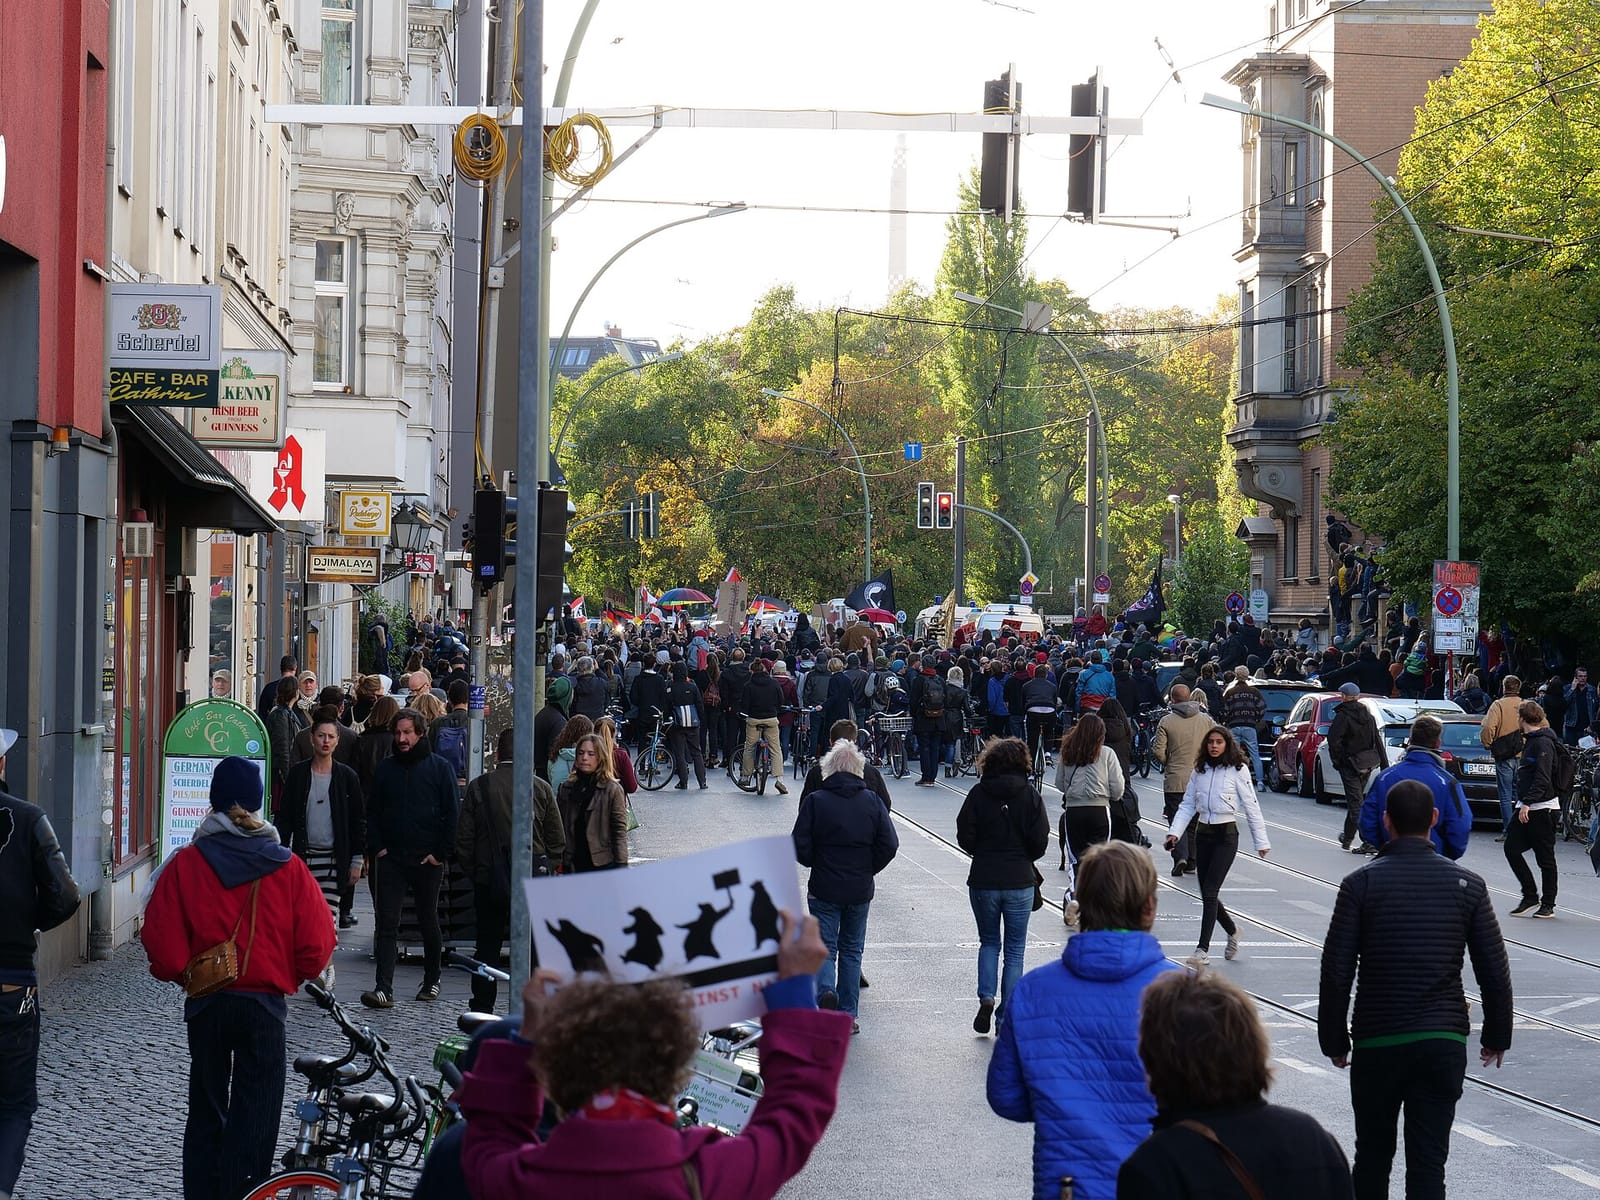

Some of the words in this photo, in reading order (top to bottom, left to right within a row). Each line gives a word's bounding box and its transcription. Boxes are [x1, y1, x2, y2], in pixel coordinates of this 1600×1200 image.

[117, 332, 200, 352] Scherdel
[110, 371, 156, 385] CAFE
[171, 373, 209, 386] BAR
[110, 384, 207, 403] Cathrin
[222, 385, 274, 401] KENNY
[212, 405, 235, 416] IRISH
[237, 406, 259, 417] BEER
[211, 422, 259, 433] GUINNESS
[908, 443, 919, 460] T
[313, 557, 373, 568] DJIMALAYA
[173, 761, 211, 773] GERMAN
[172, 778, 209, 788] SCHERDEL
